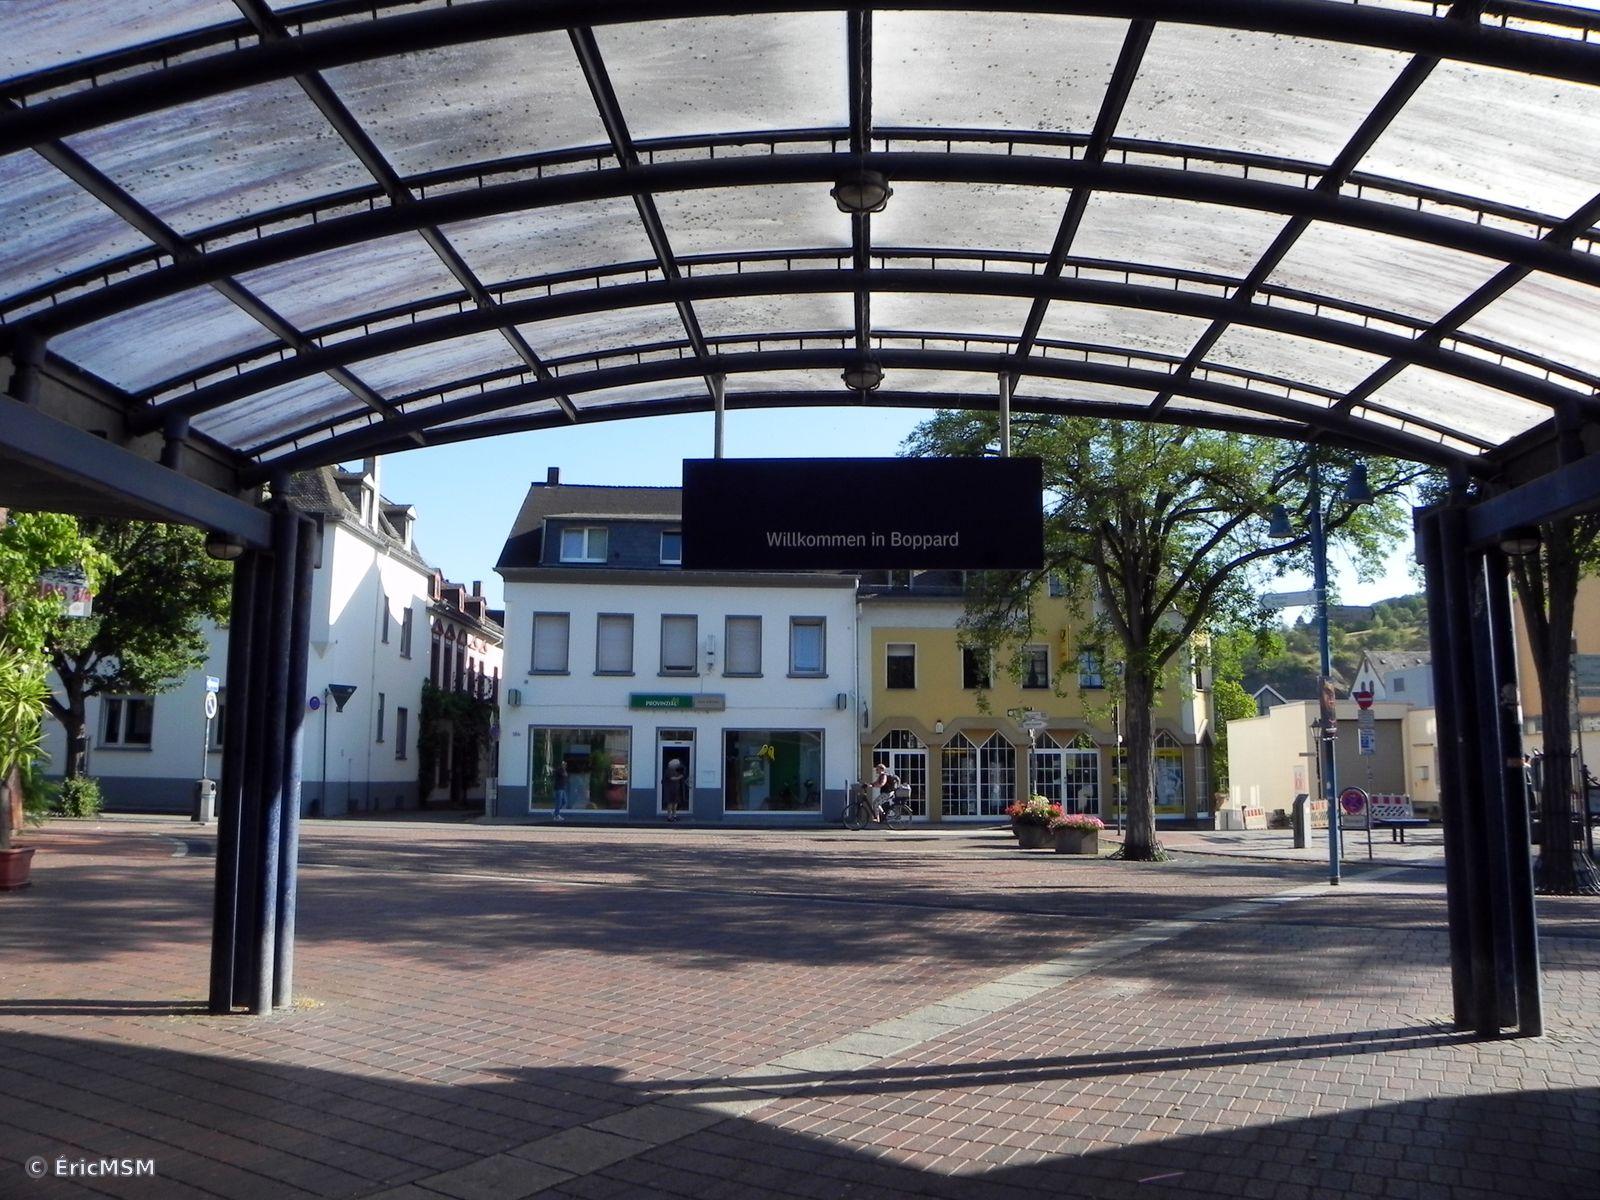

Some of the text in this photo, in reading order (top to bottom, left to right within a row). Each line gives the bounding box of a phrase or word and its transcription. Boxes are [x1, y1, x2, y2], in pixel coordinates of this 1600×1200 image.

[766, 531, 960, 550] Willkommen in Boppard
